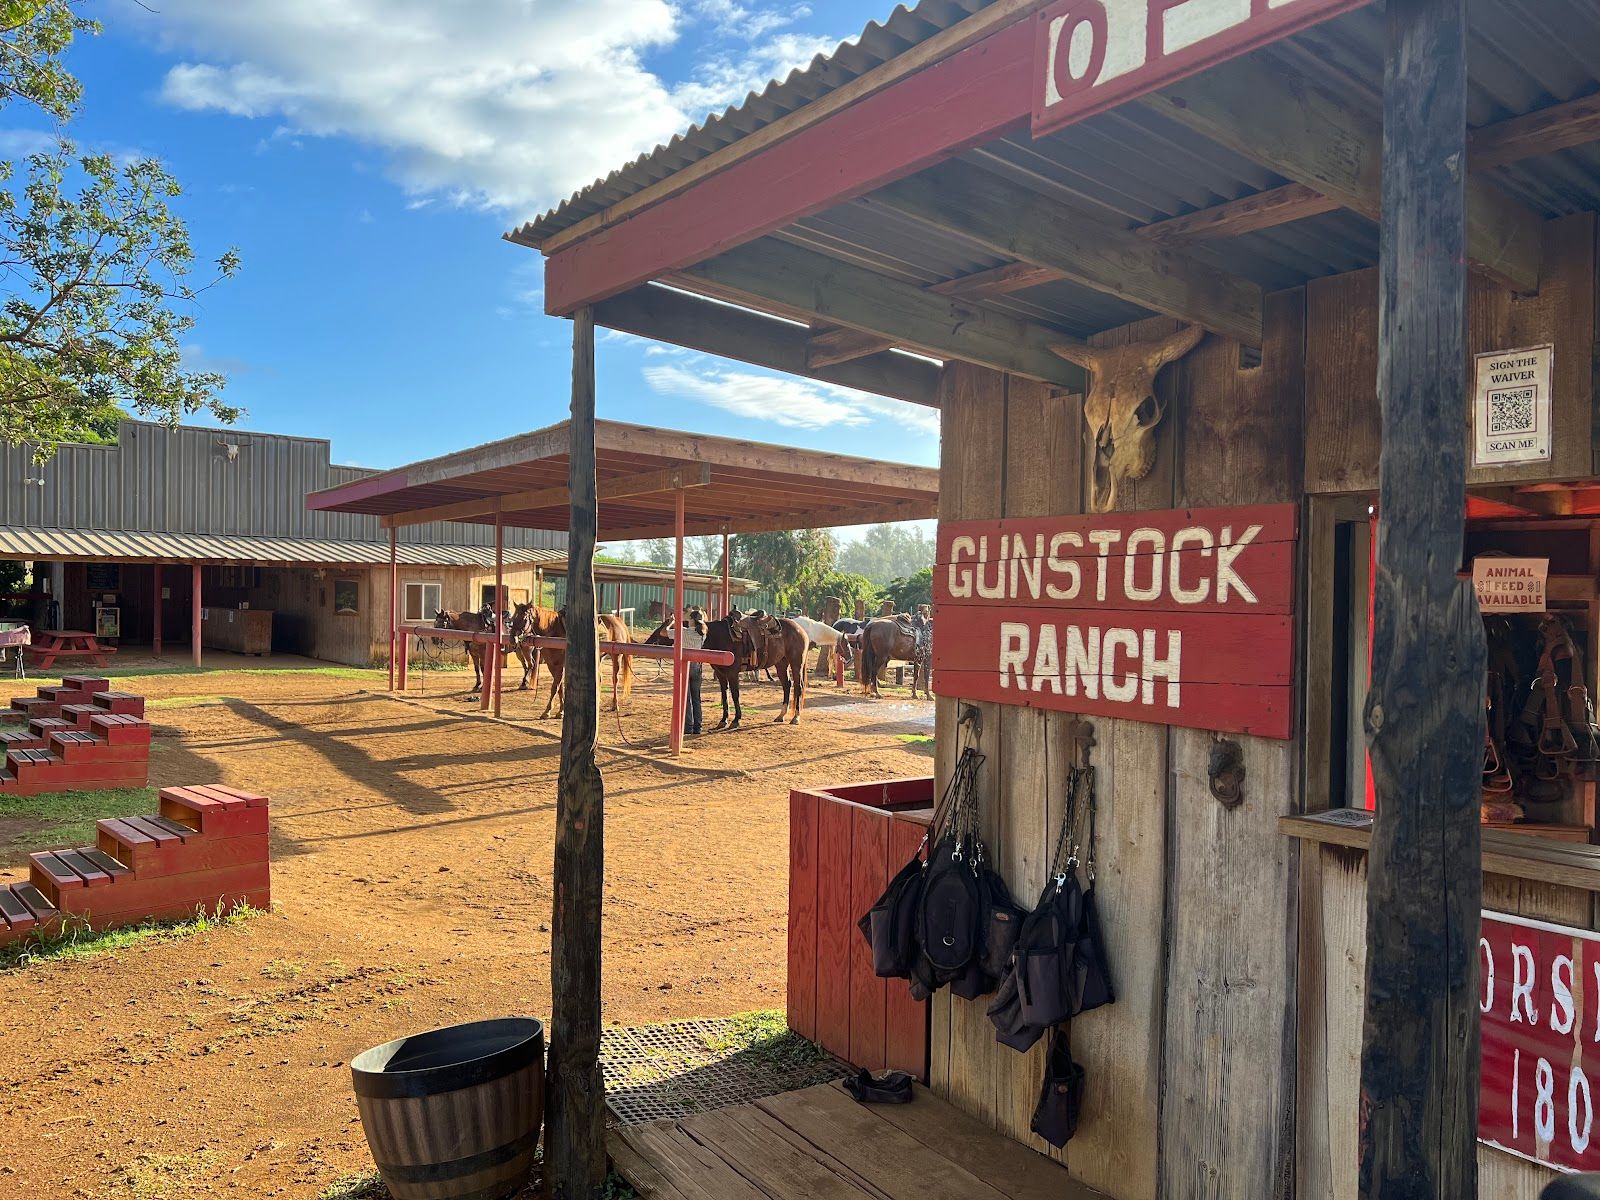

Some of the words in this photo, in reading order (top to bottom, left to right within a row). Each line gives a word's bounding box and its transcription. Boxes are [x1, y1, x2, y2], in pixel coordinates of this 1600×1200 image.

[1490, 360, 1514, 371] SIGN
[1517, 357, 1537, 368] THE
[1491, 370, 1535, 383] WAIVER
[1490, 441, 1516, 451] SCAN
[1518, 440, 1534, 449] ME
[948, 524, 1264, 605] GUNSTOCK
[1486, 567, 1534, 578] ANIMAL
[1494, 581, 1524, 591] FEED
[998, 621, 1182, 708] RANCH
